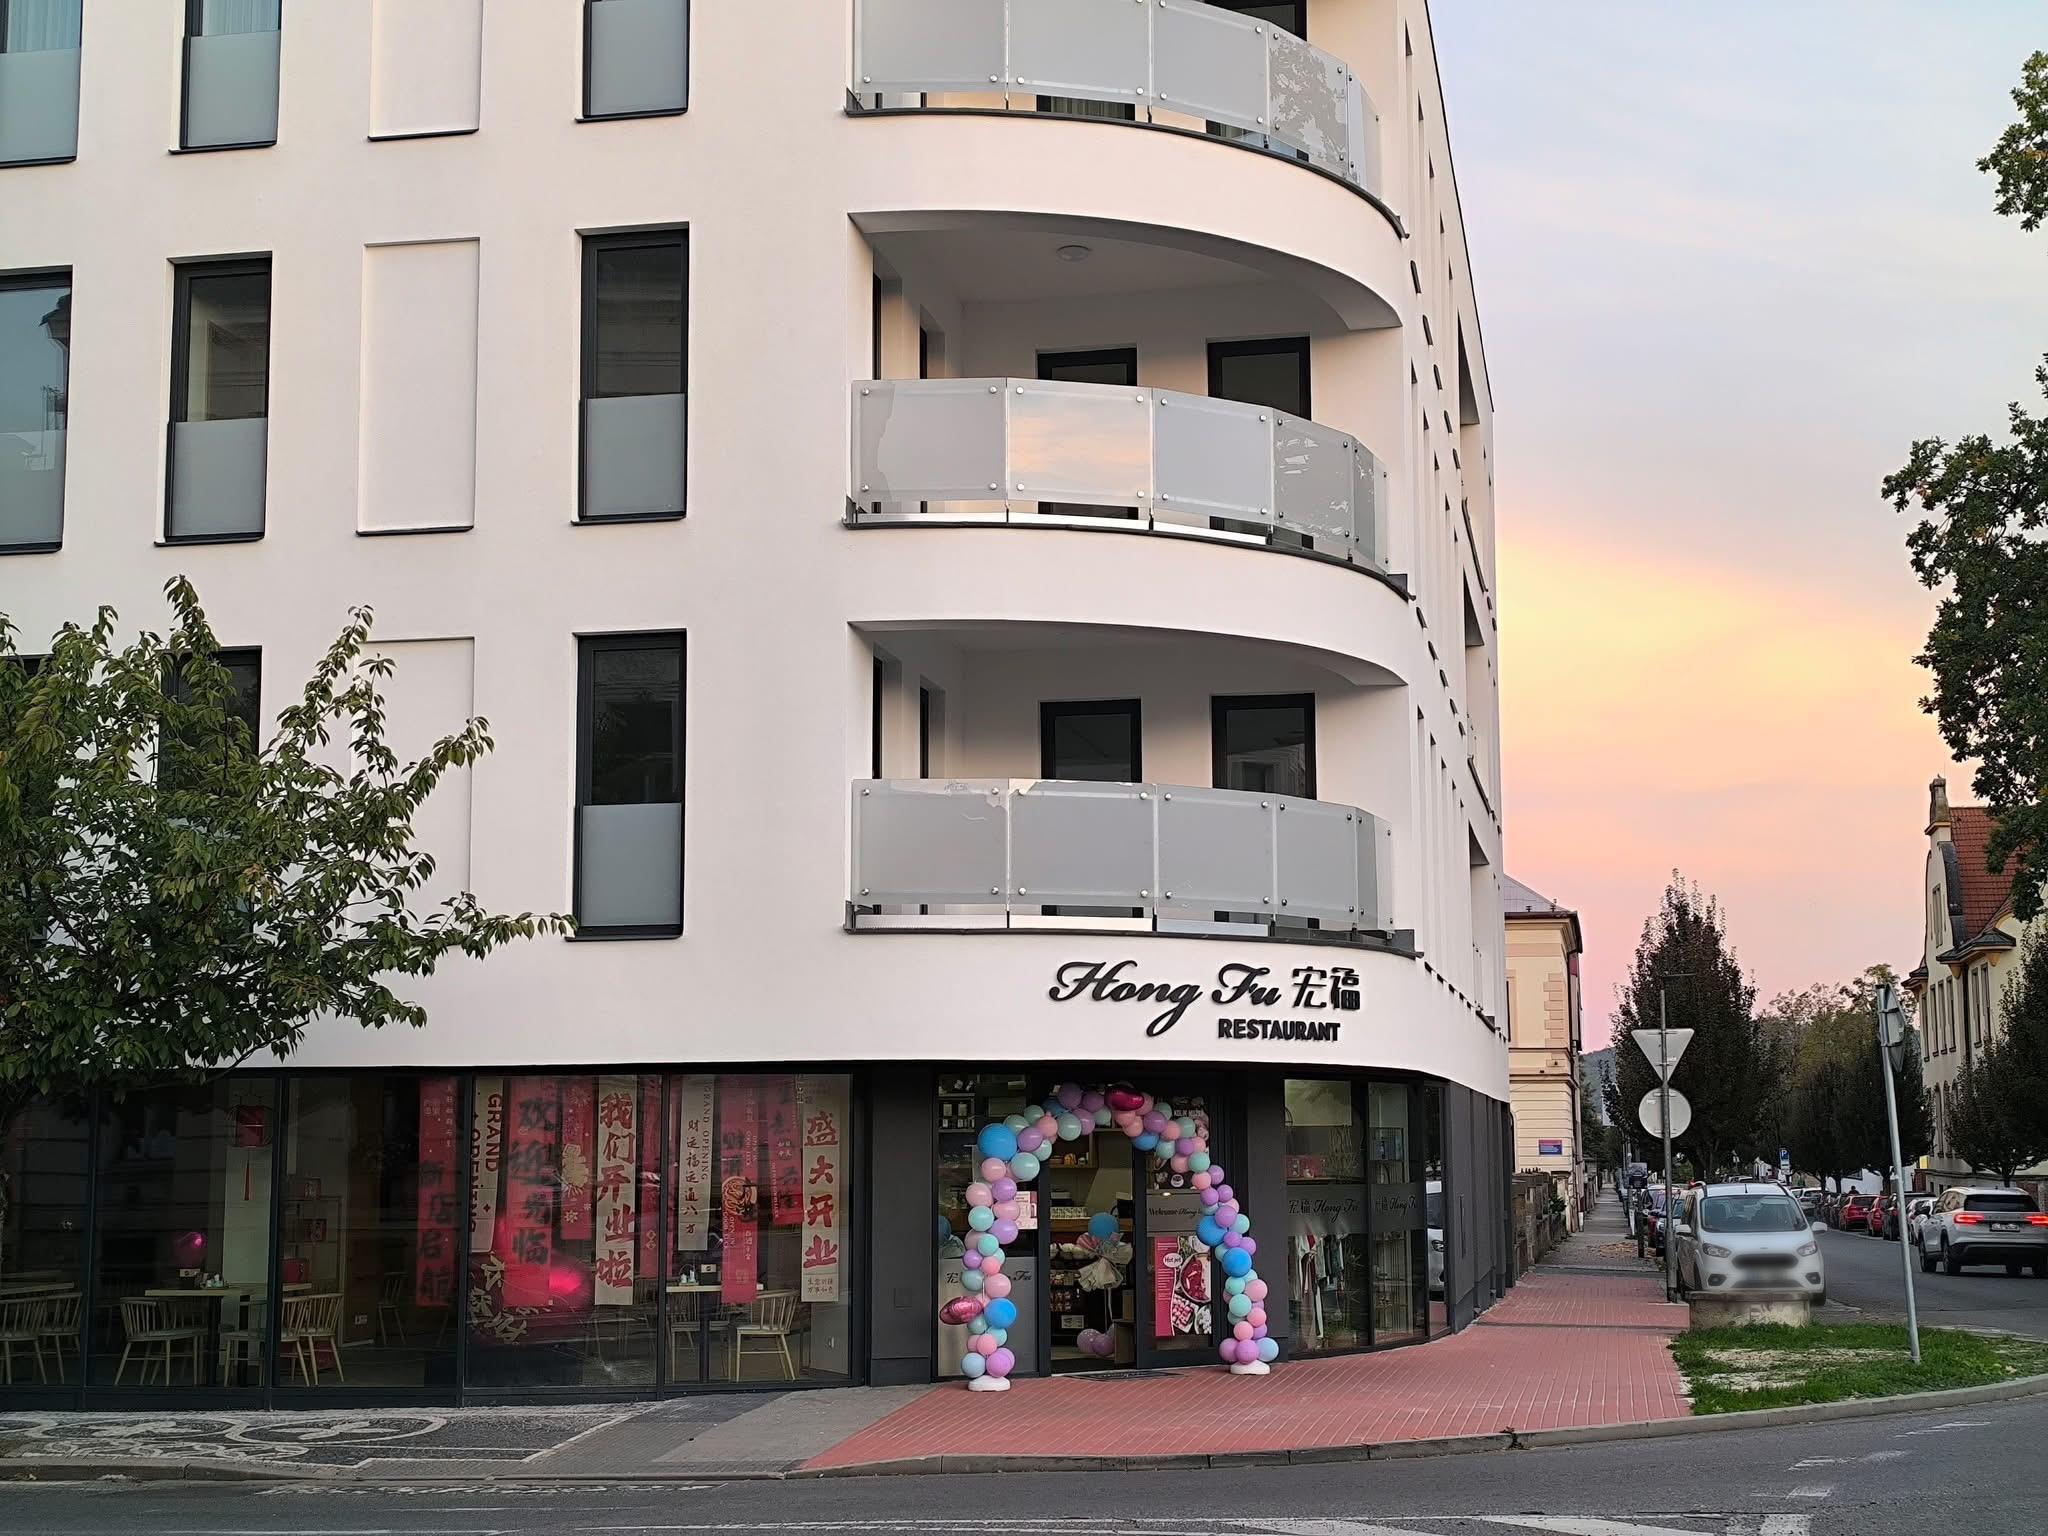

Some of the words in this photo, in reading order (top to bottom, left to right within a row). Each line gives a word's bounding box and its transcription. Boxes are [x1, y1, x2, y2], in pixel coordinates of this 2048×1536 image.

[1049, 960, 1203, 1038] Hong
[1211, 963, 1282, 1005] Fu
[1218, 1018, 1341, 1042] RESTAURANT
[703, 1085, 711, 1123] GRAND
[486, 1093, 503, 1173] GRAND
[701, 1130, 710, 1181] OPENING
[1781, 1149, 1788, 1157] P
[596, 1092, 636, 1288] 我们开业啦
[804, 1111, 839, 1269] 盛大开业
[1313, 1199, 1342, 1223] Hong
